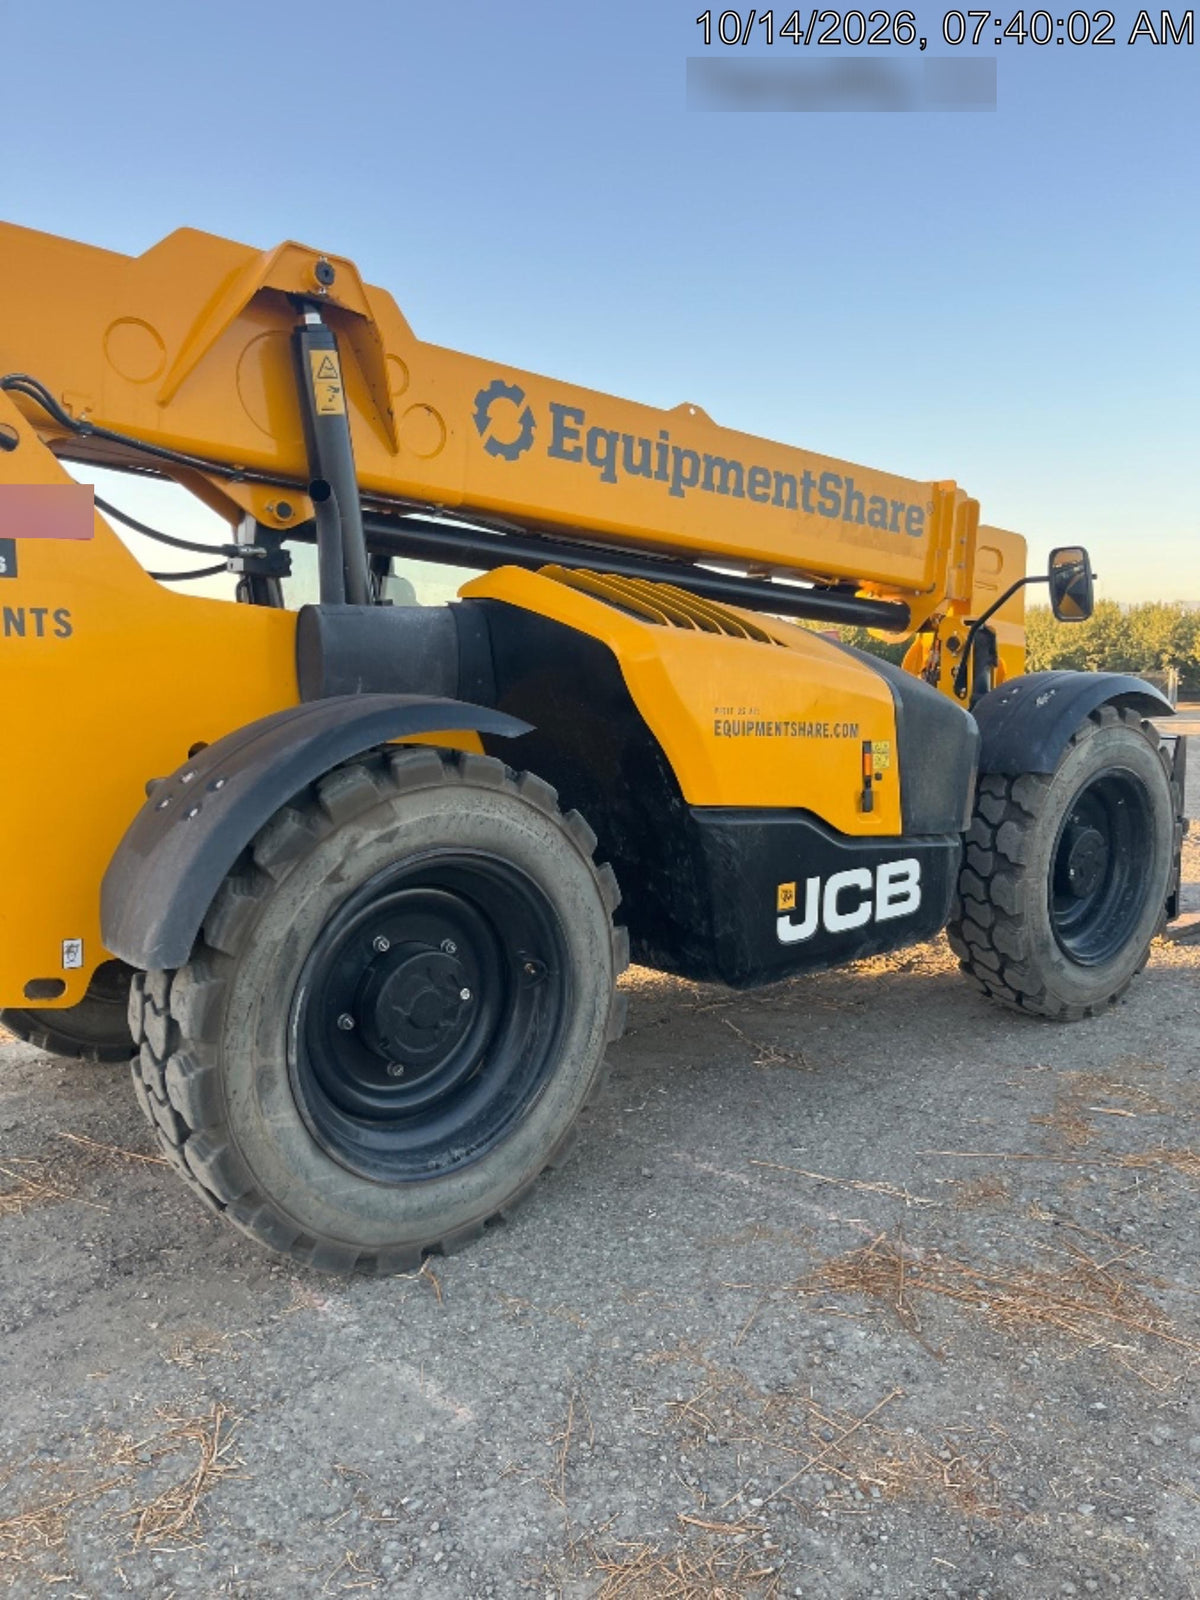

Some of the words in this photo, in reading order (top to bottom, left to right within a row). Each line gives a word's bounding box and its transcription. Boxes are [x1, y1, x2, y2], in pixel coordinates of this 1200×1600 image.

[548, 402, 925, 538] EquipmentShare
[713, 719, 859, 738] EQUIPMENTSHARE.COM
[776, 858, 922, 945] JCB
